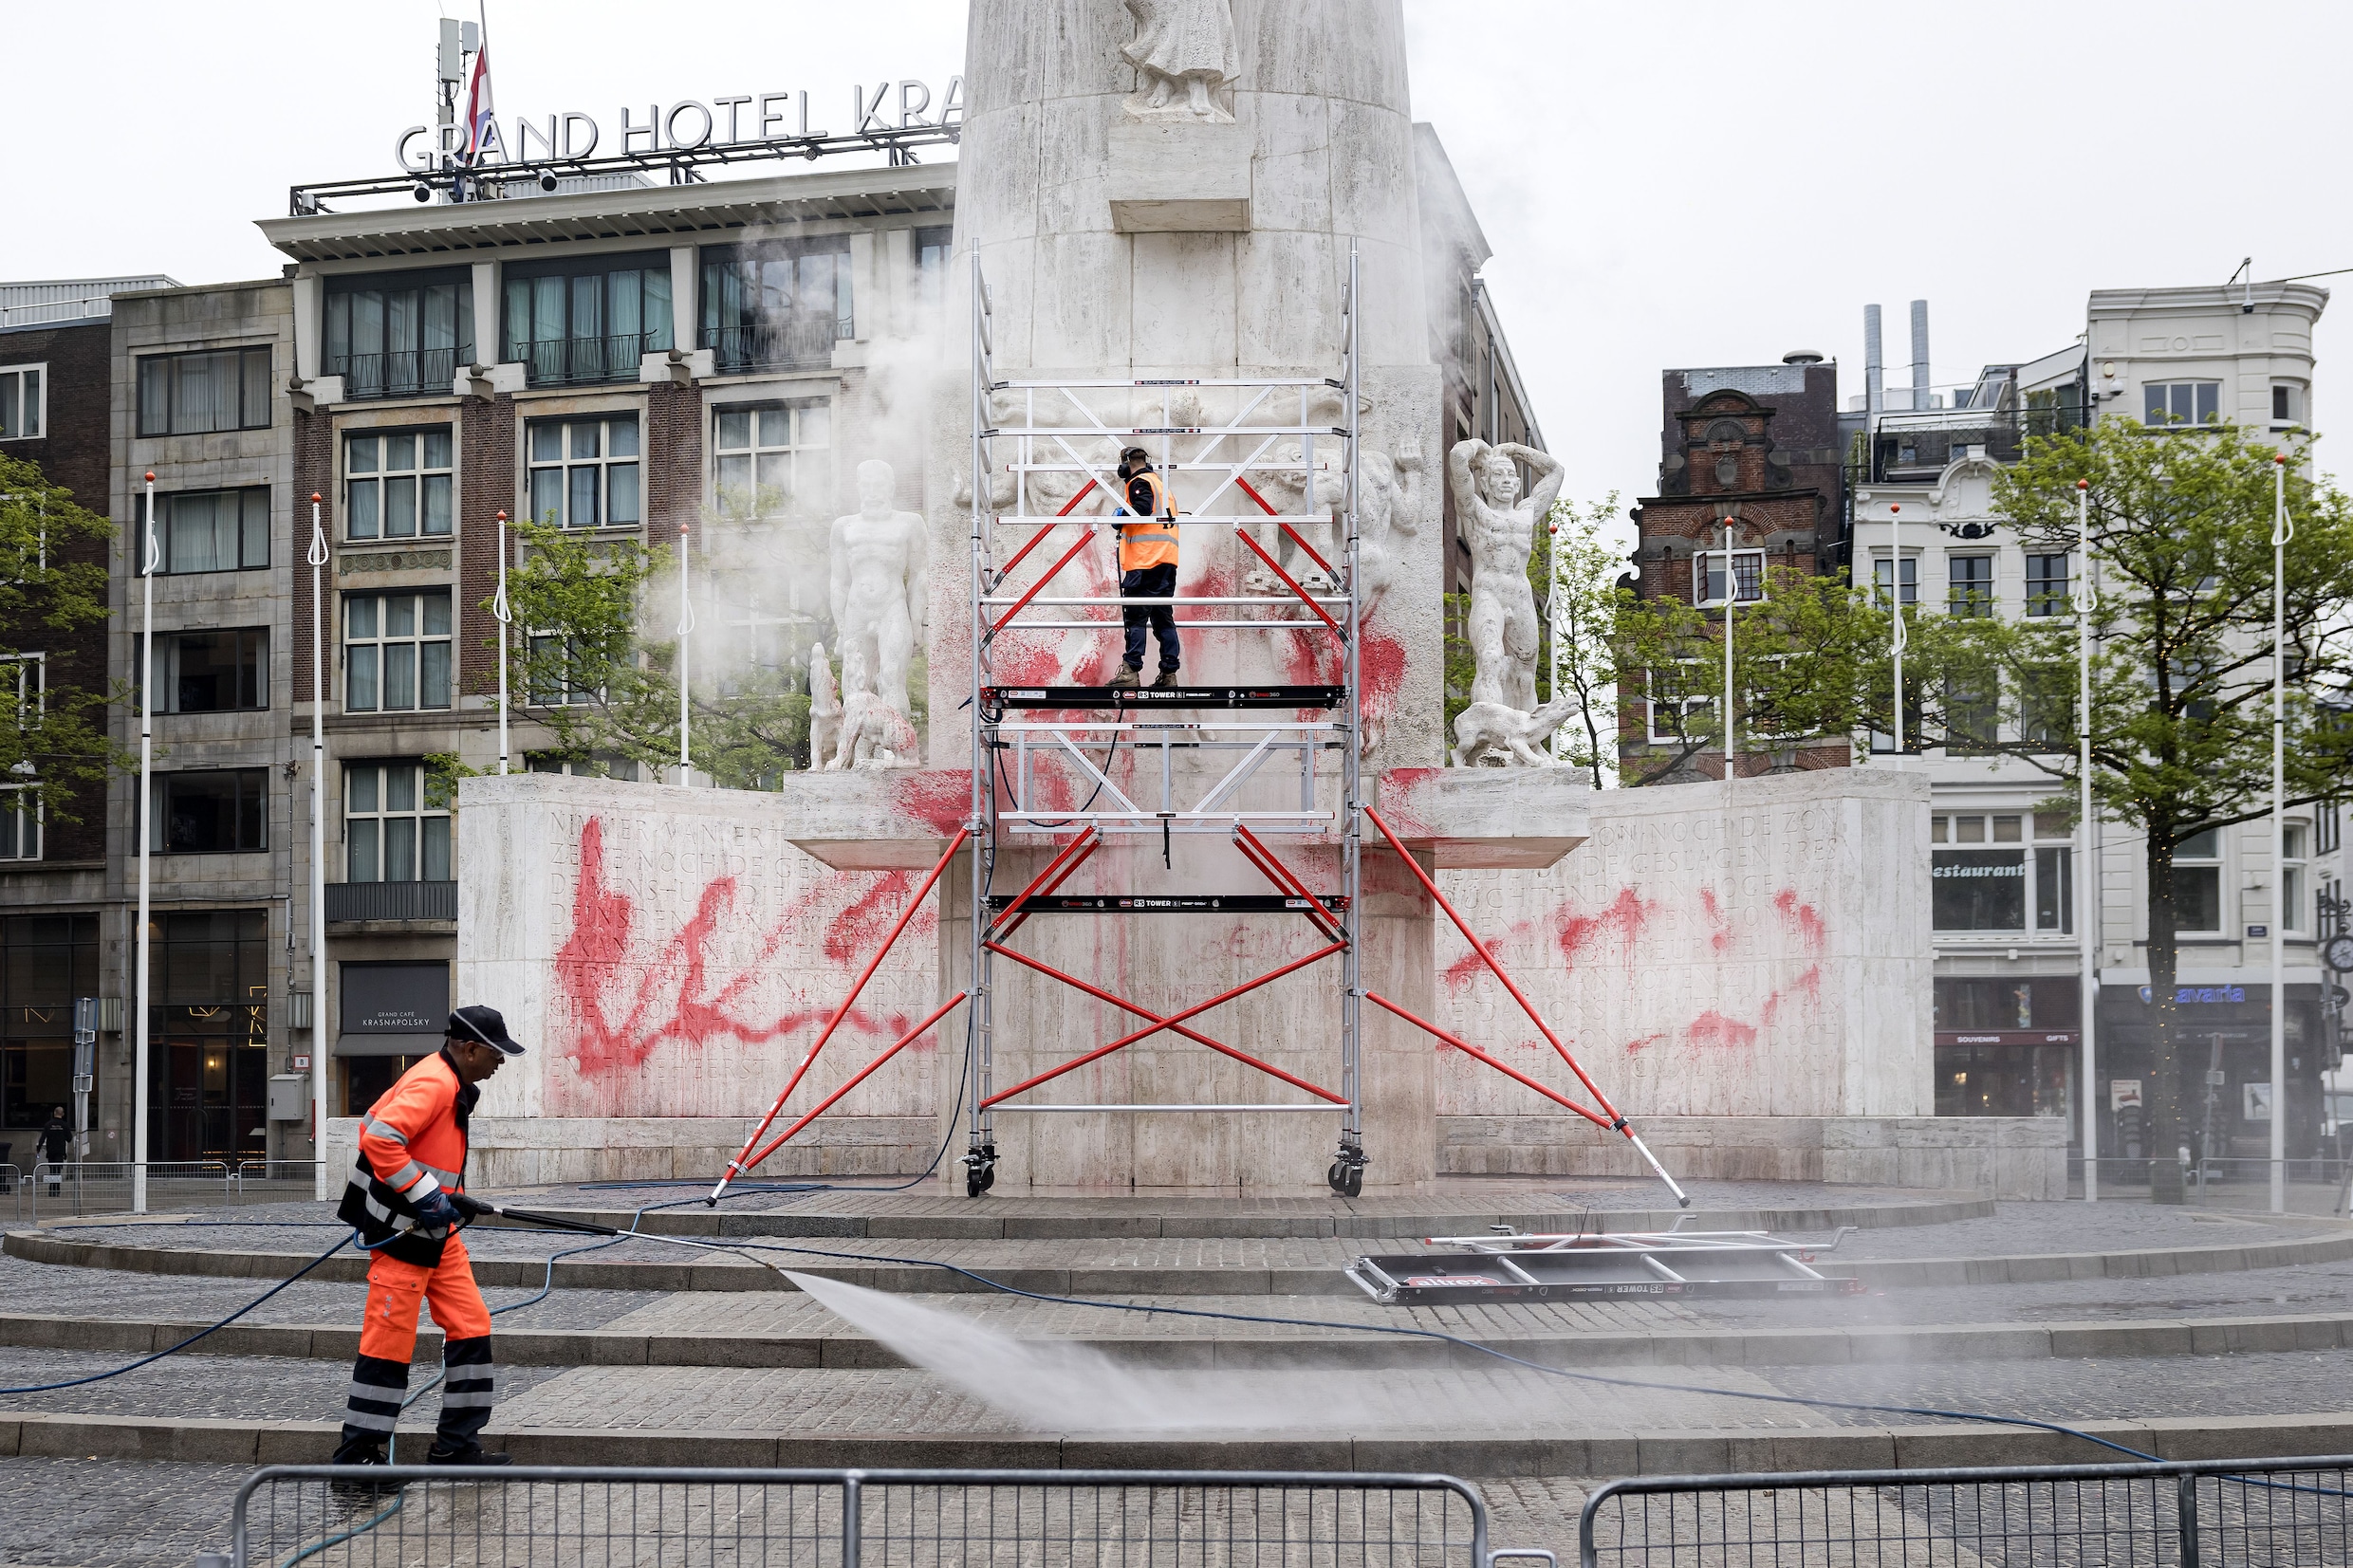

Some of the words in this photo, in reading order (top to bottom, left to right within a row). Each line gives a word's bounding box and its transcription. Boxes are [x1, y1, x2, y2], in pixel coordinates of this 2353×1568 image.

[395, 111, 599, 174] GRAND
[621, 89, 828, 155] HOTEL
[662, 821, 718, 846] VAN
[1650, 818, 1731, 844] NOCH
[1740, 813, 1772, 838] DE
[1781, 808, 1839, 835] ZON
[637, 849, 716, 875] NOCH
[729, 855, 763, 877] DE
[1583, 854, 1620, 877] DE
[1630, 845, 1771, 875] GESLAGEN
[1781, 837, 1839, 864] BRES
[1932, 863, 2026, 877] estaurant
[739, 884, 785, 908] DIE
[1438, 883, 1612, 910] DUCHTEND
[1699, 874, 1773, 900] HOGE
[1665, 908, 1696, 932] EN
[1436, 971, 1537, 995] BODN
[2176, 985, 2246, 1004] avaria
[1548, 1000, 1605, 1022] ONS
[1765, 1024, 1838, 1046] DOCH
[639, 1057, 770, 1079] BEHEERST
[784, 1058, 841, 1080] VN
[1416, 1278, 1489, 1286] altrex
[1616, 1284, 1649, 1293] TOWER
